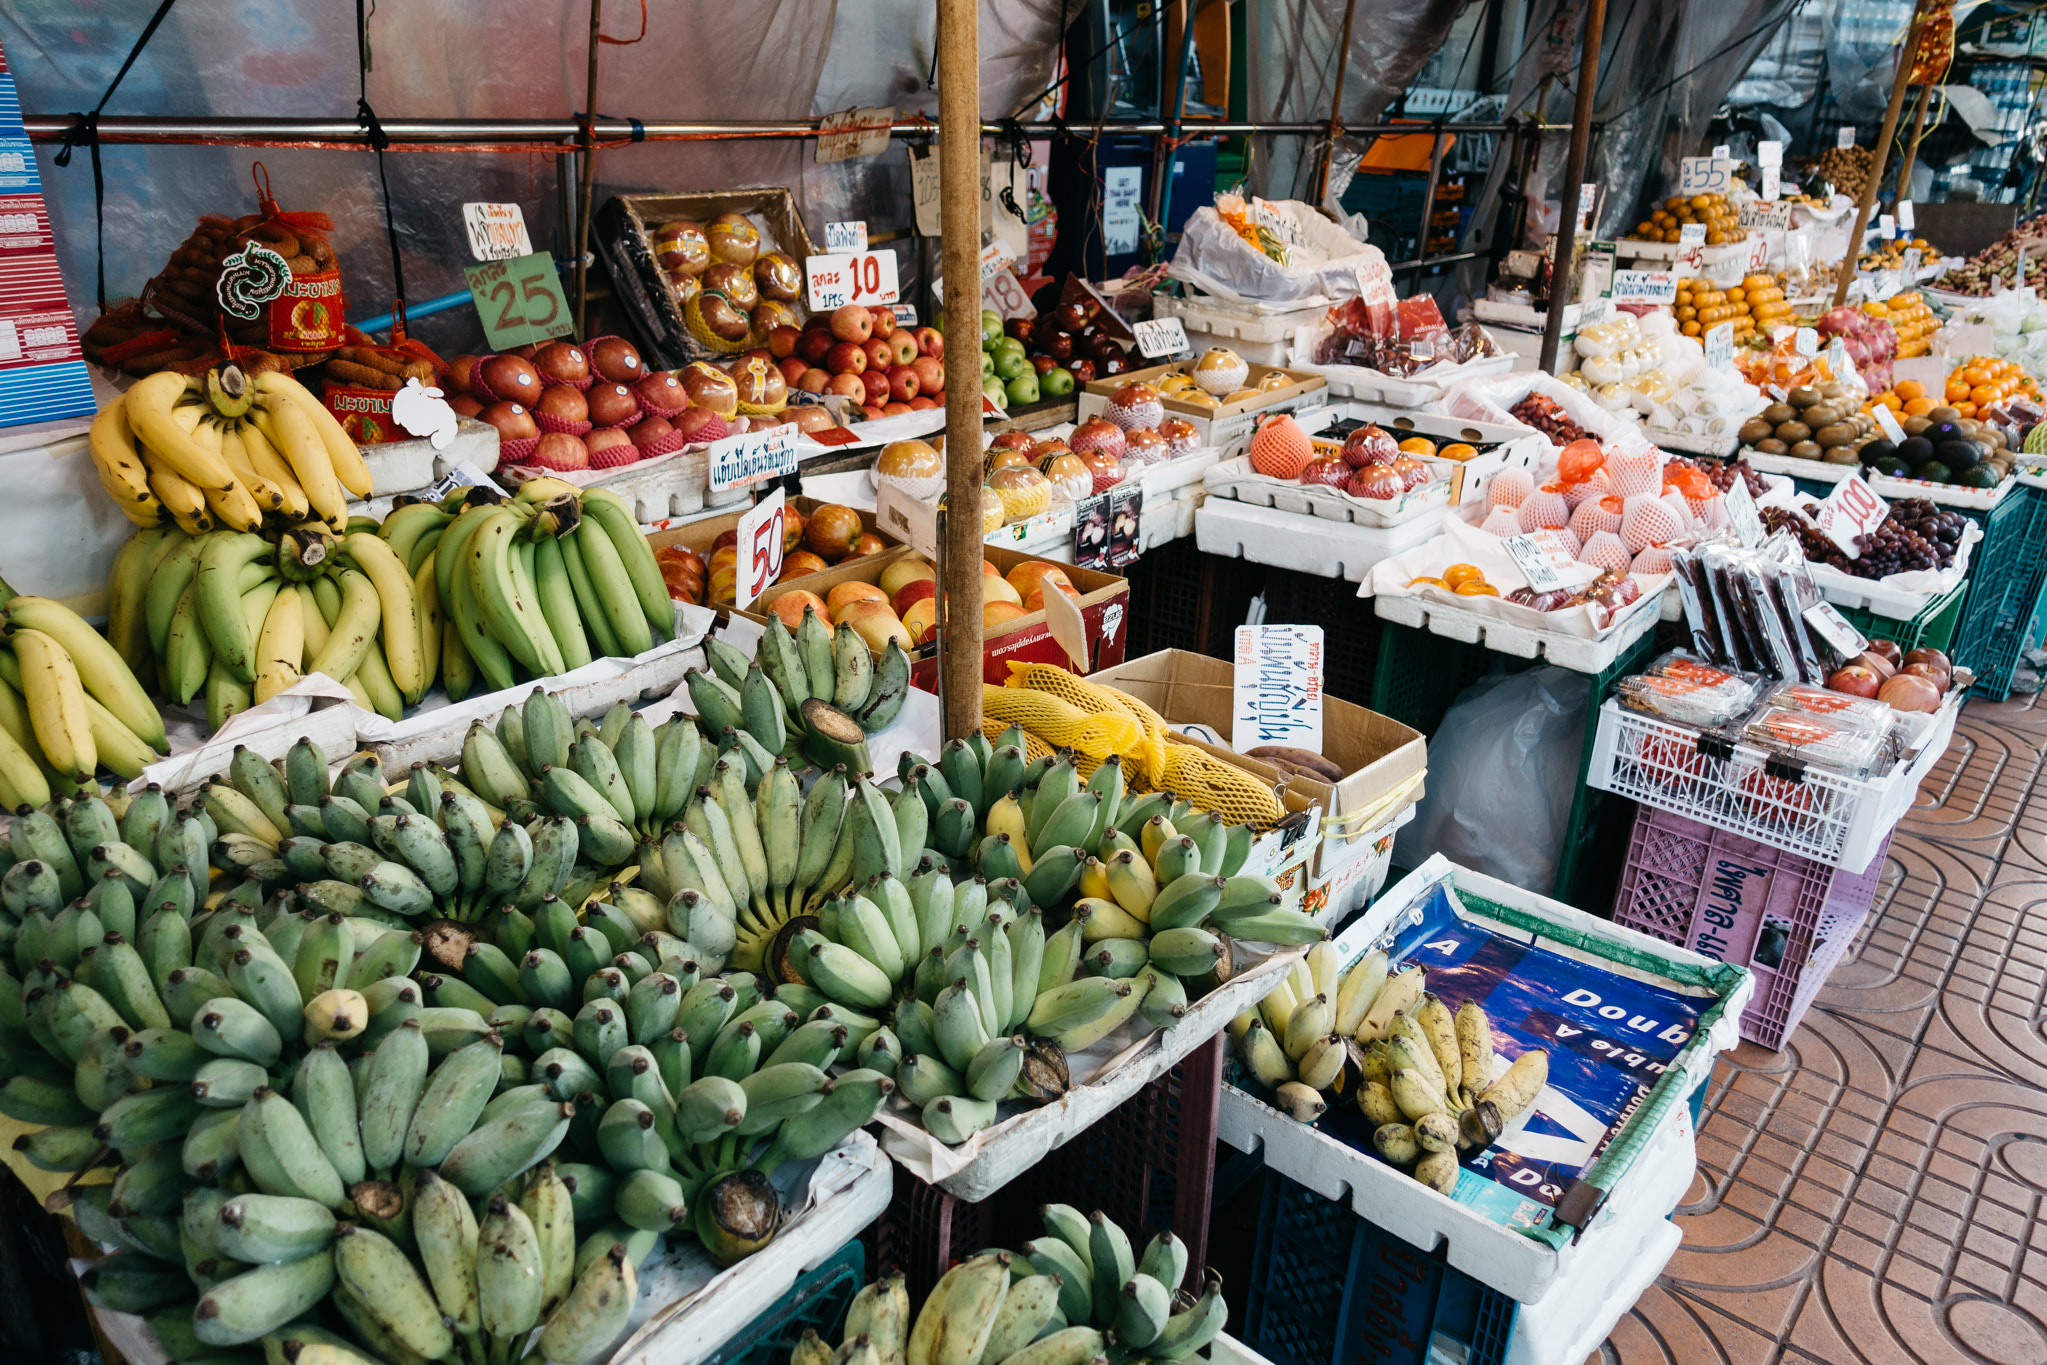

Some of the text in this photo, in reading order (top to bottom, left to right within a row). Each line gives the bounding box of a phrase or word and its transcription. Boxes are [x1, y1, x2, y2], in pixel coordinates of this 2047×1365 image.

[1694, 159, 1725, 188] 55
[812, 255, 880, 301] ลูกละ 10
[1749, 241, 1767, 270] 60
[490, 274, 559, 331] 25
[1836, 478, 1877, 536] 100
[751, 506, 784, 598] 50
